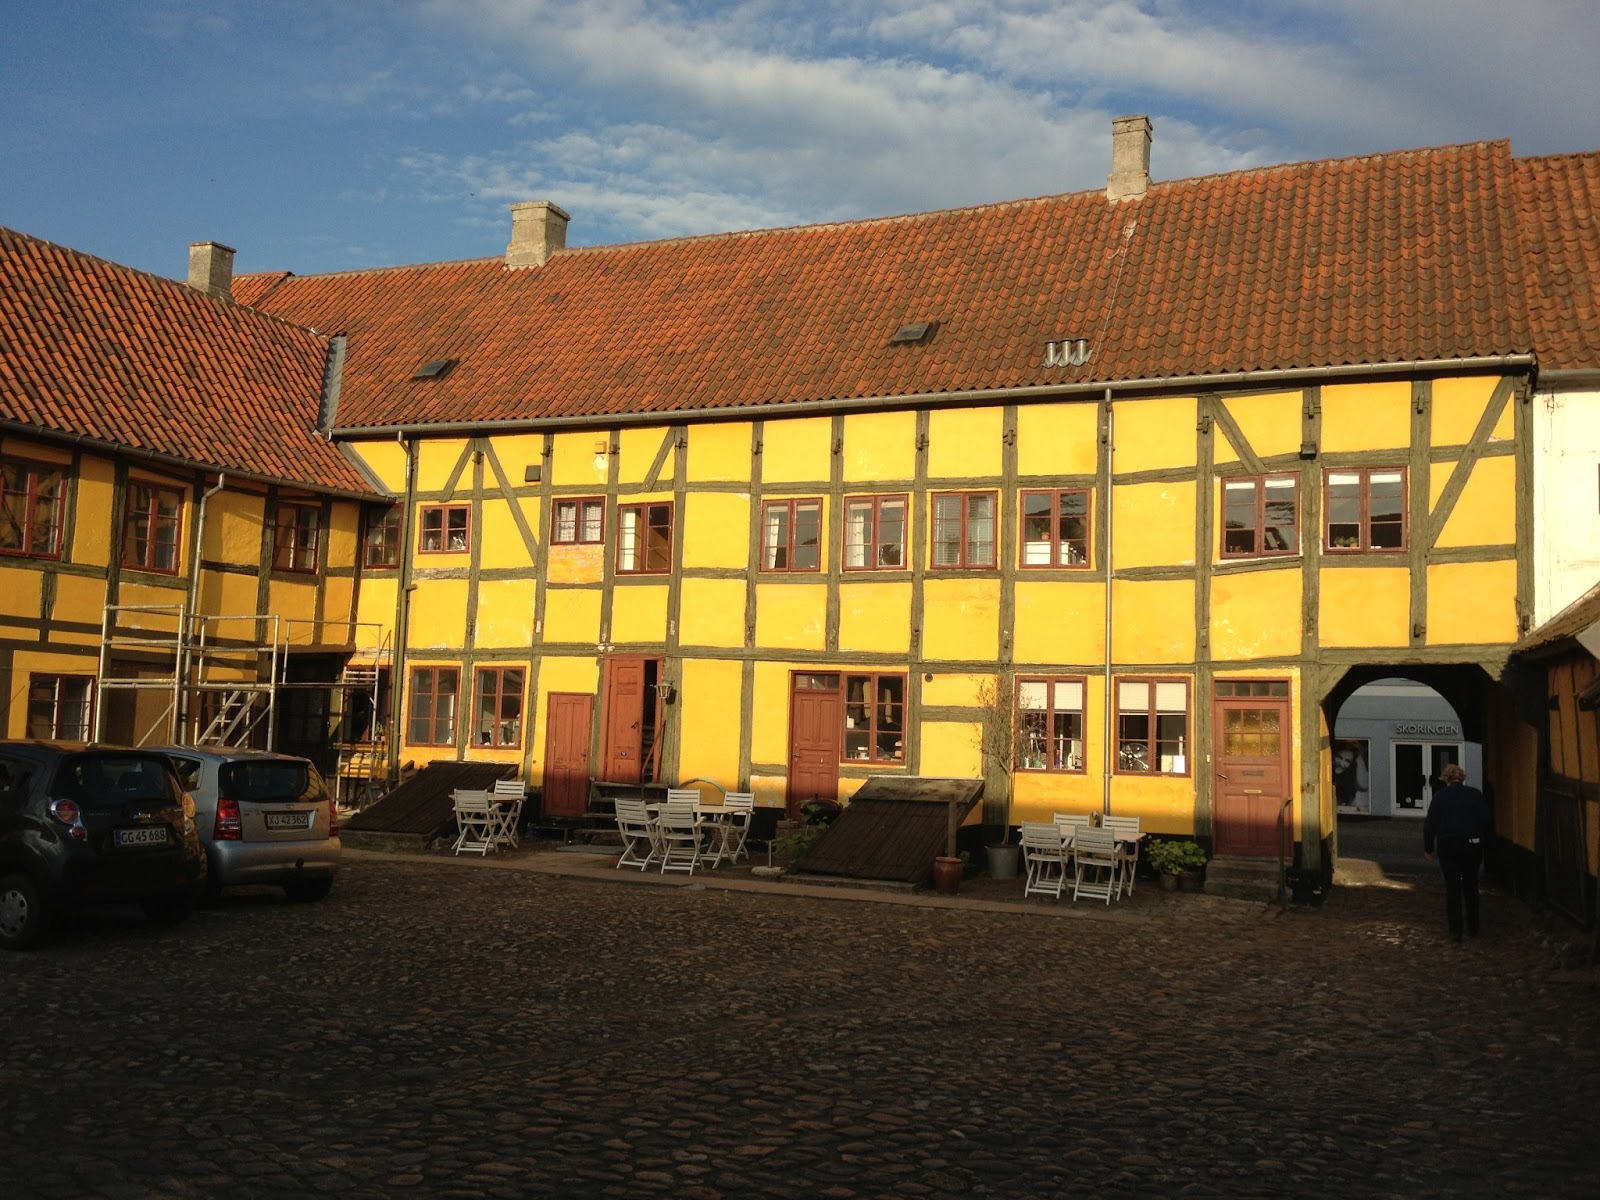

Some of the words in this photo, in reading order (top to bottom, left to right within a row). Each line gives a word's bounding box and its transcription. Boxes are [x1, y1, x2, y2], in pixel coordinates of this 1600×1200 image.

[1396, 724, 1459, 735] SKORINGEN
[268, 815, 279, 825] XJ
[121, 832, 134, 843] GG
[136, 830, 147, 841] 45
[148, 829, 166, 841] 688
